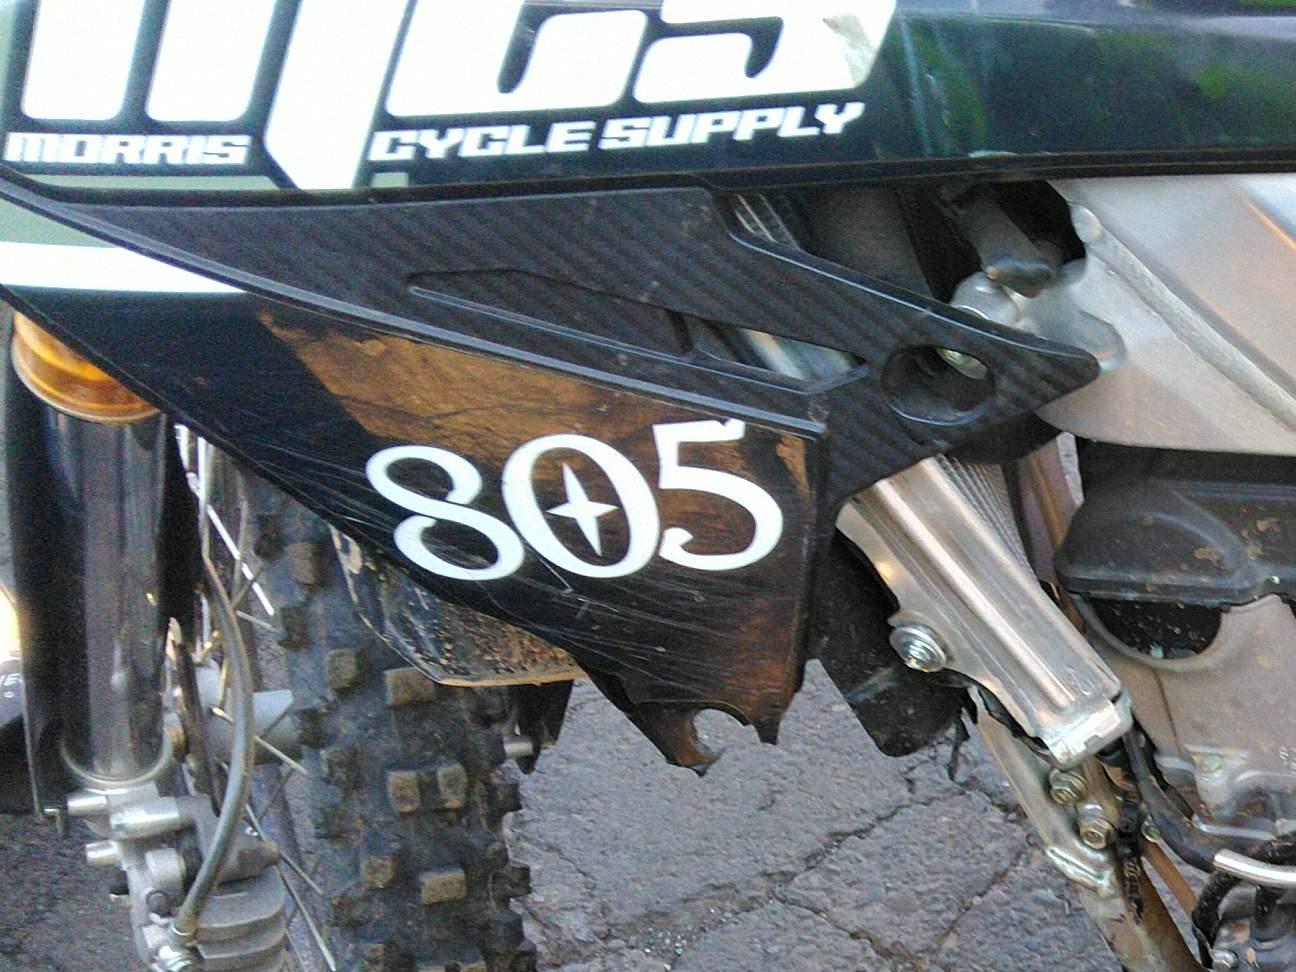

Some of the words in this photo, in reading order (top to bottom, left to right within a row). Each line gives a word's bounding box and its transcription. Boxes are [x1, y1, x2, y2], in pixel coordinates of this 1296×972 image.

[4, 132, 252, 165] MORRIS
[369, 119, 597, 161] CYCLE
[598, 102, 865, 151] SUPPLY
[366, 419, 783, 580] 805
